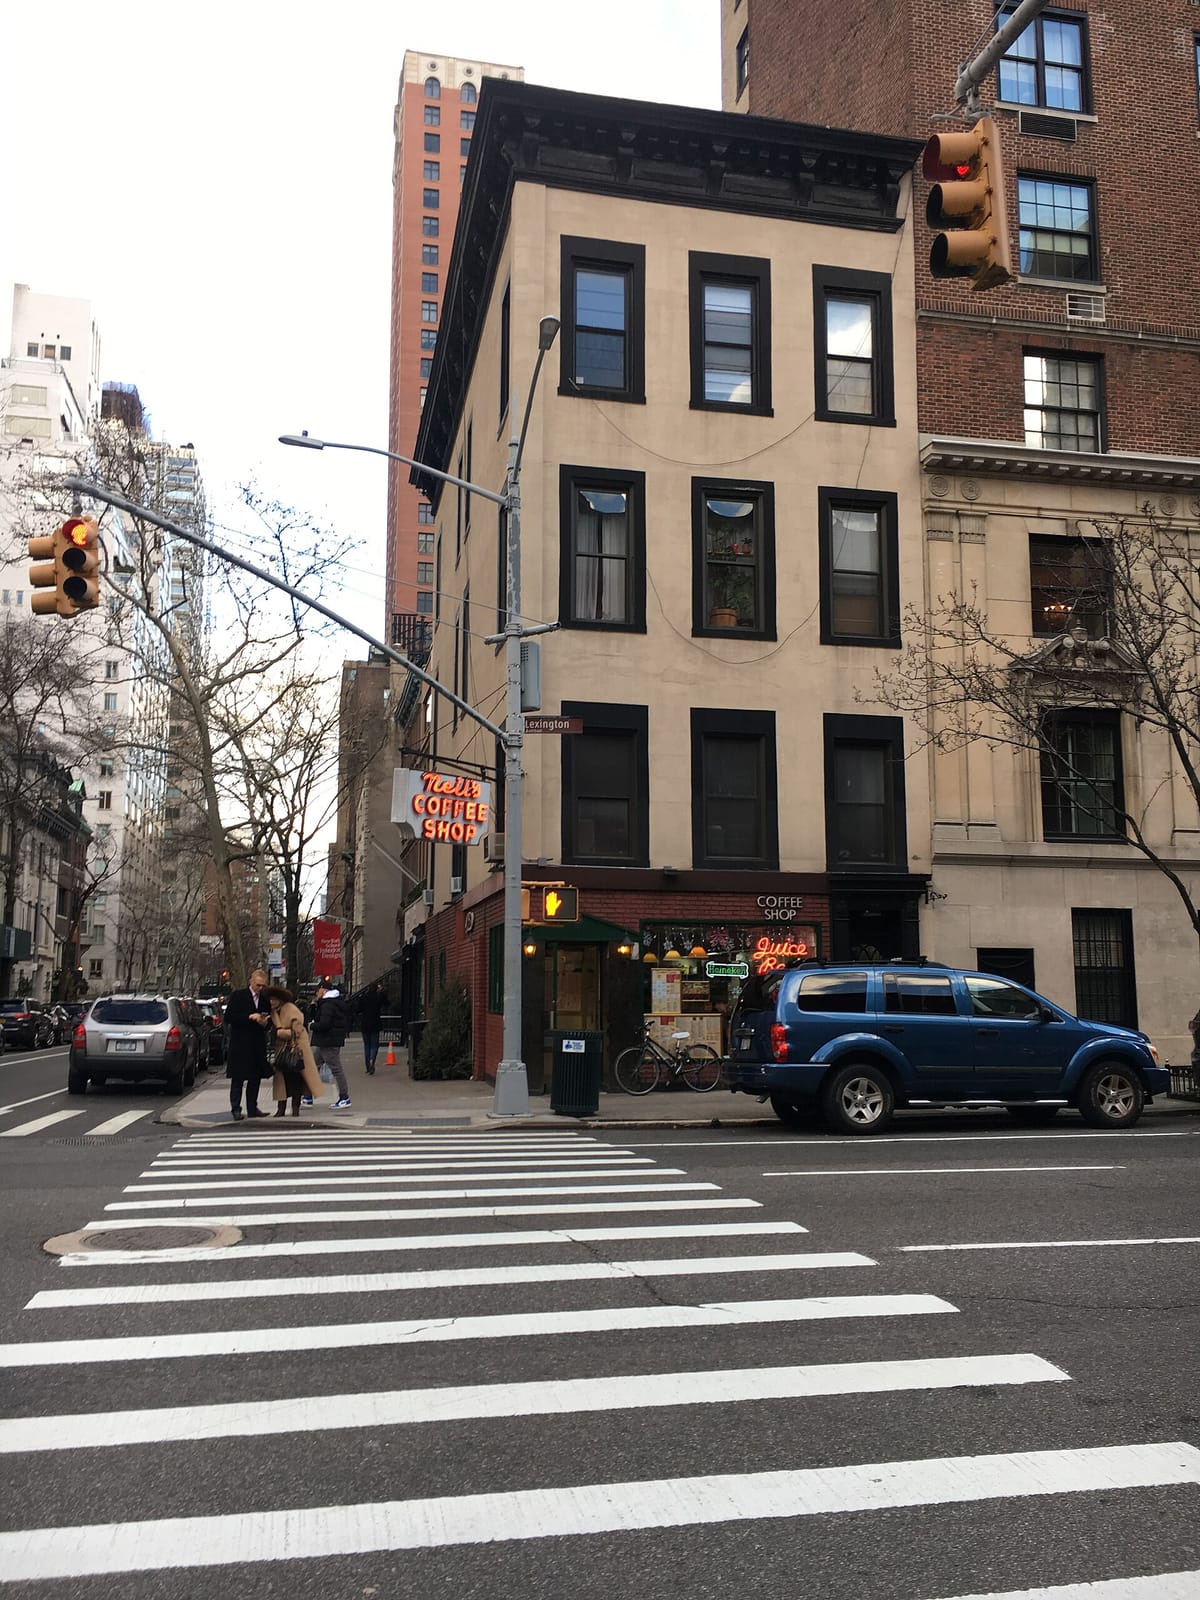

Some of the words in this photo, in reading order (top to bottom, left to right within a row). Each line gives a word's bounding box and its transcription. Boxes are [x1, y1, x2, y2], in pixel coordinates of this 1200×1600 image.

[525, 719, 570, 731] Lexington
[413, 793, 489, 822] COFFEE
[422, 818, 478, 842] SHOP
[757, 895, 803, 908] COFFEE
[764, 908, 797, 920] SHOP
[753, 936, 808, 959] Juice
[708, 964, 746, 975] Heineken
